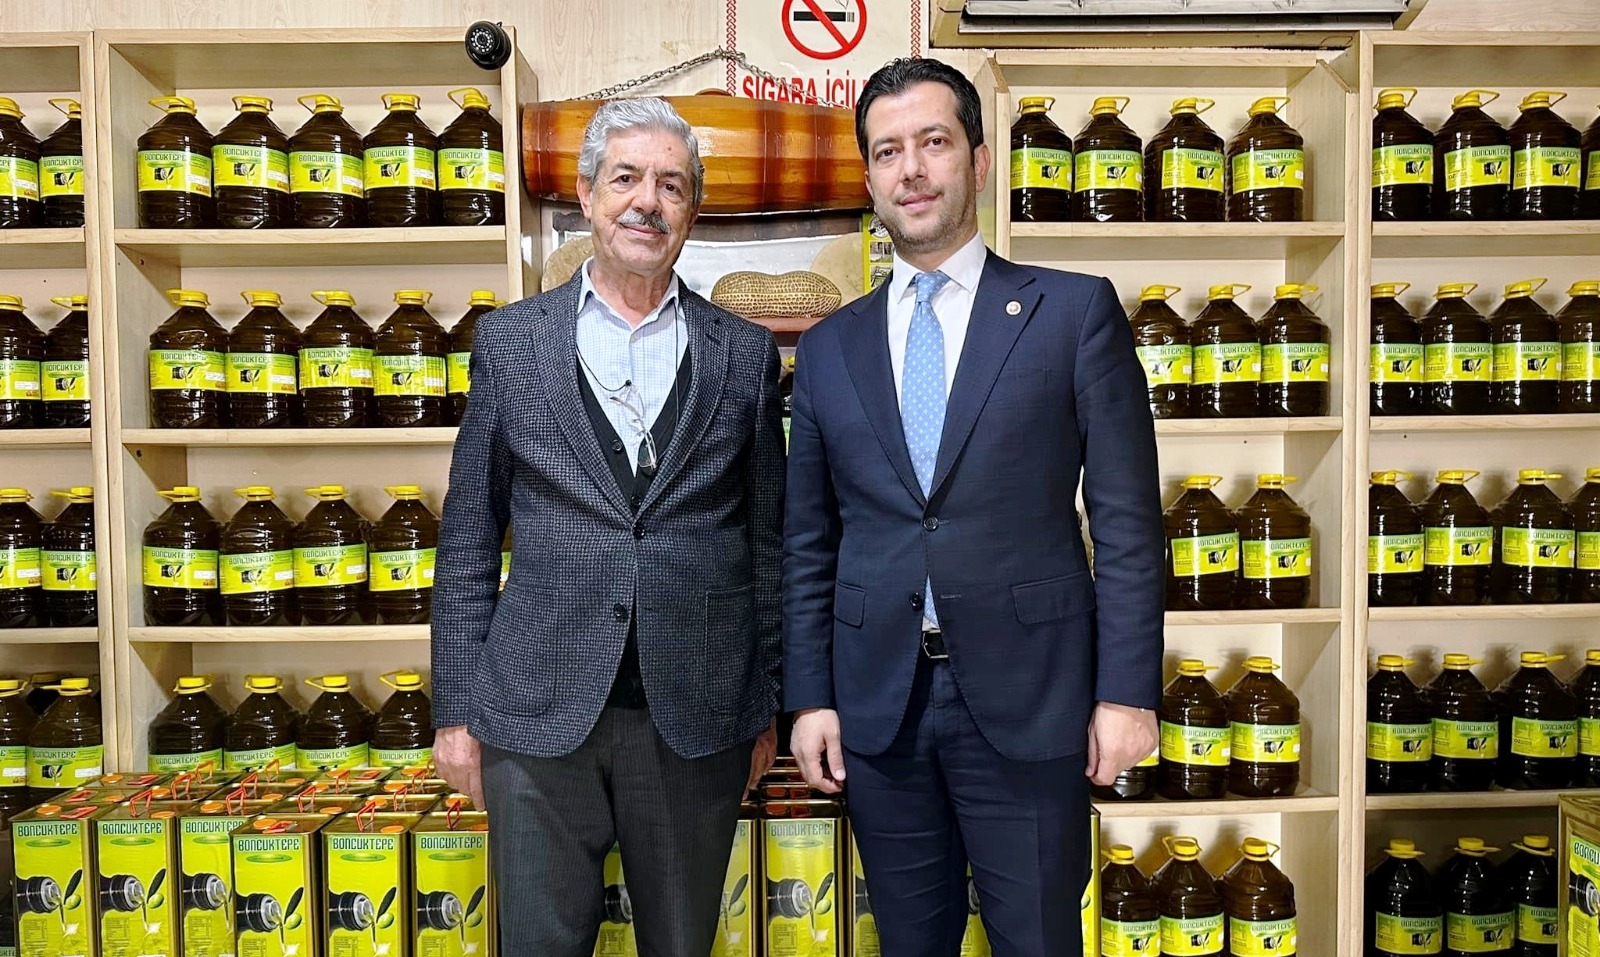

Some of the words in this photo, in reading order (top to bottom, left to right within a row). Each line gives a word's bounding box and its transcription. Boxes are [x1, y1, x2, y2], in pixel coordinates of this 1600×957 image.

[743, 75, 817, 105] SIGARA
[44, 159, 83, 167] BONCUKTEP
[18, 824, 78, 836] BONCUKTEPE
[102, 822, 162, 835] BONCUKTEPE
[186, 821, 244, 832] BONCUKTEP
[770, 823, 830, 836] BONCUKTEPE
[238, 838, 300, 852] BONCUKTEPE
[333, 838, 394, 850] BONCUKTEPE
[420, 837, 482, 849] BONCUKTEPE
